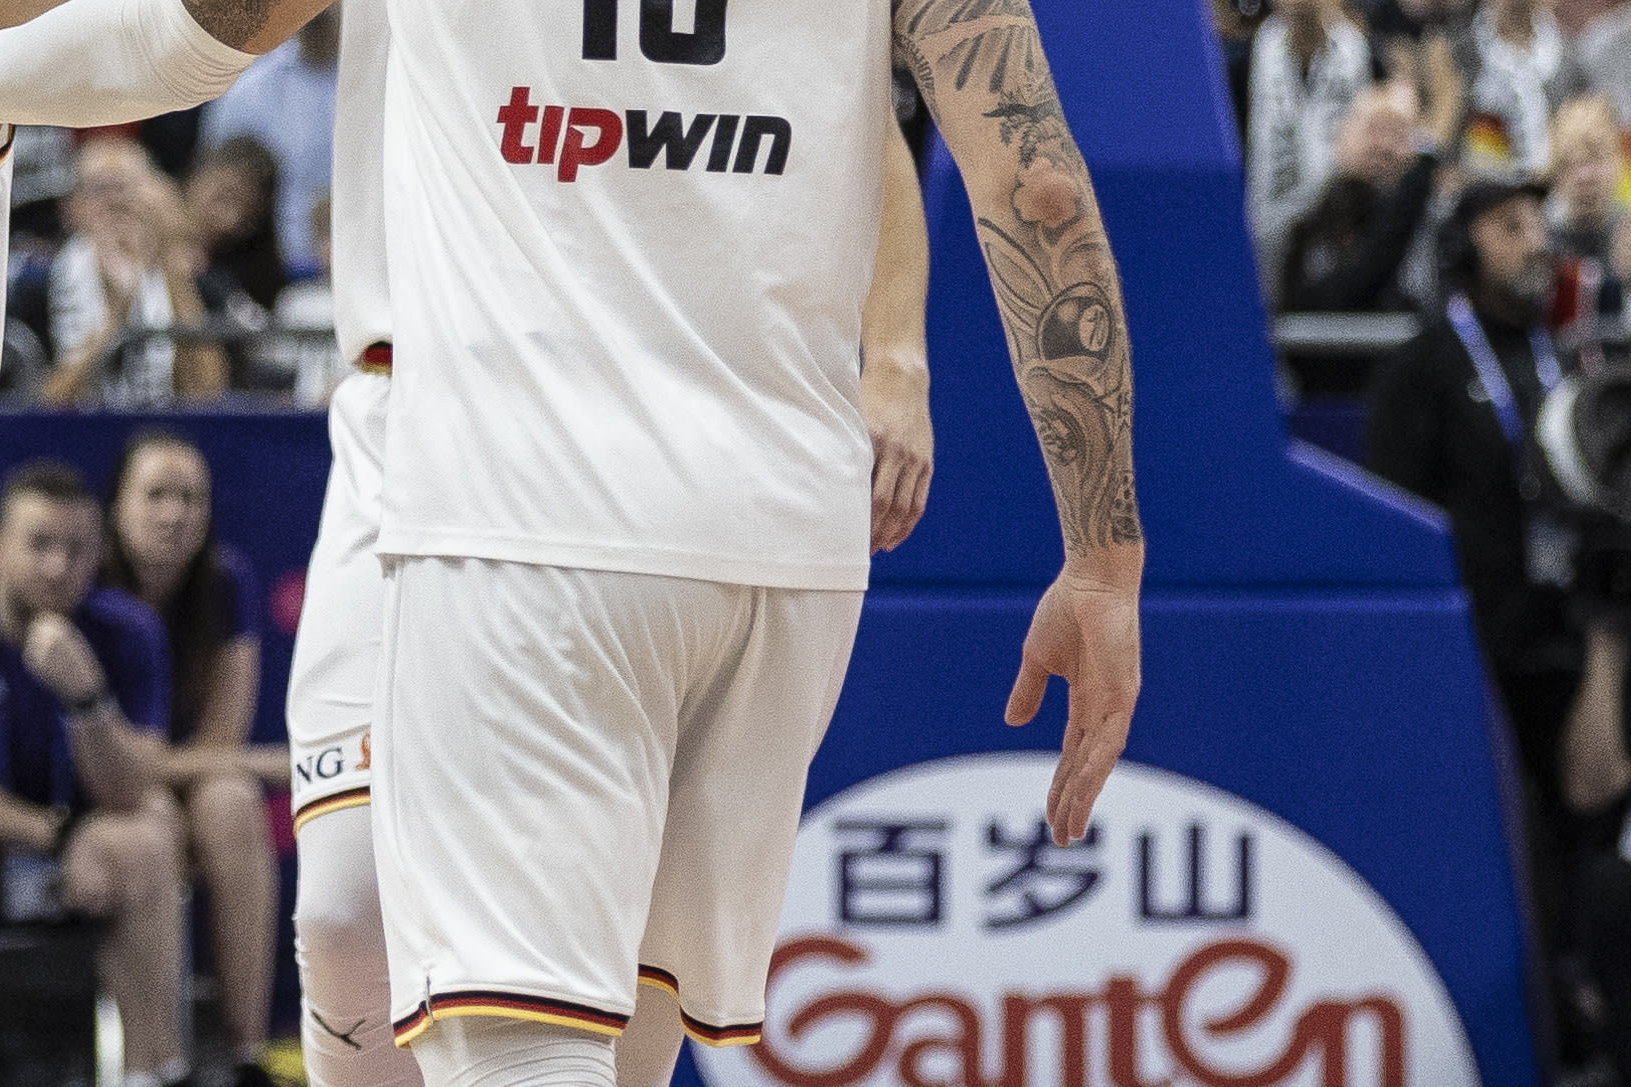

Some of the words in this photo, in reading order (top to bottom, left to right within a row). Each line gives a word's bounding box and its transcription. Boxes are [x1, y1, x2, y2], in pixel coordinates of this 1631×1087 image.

[497, 87, 793, 183] tipwin
[833, 817, 1256, 932] 百岁山
